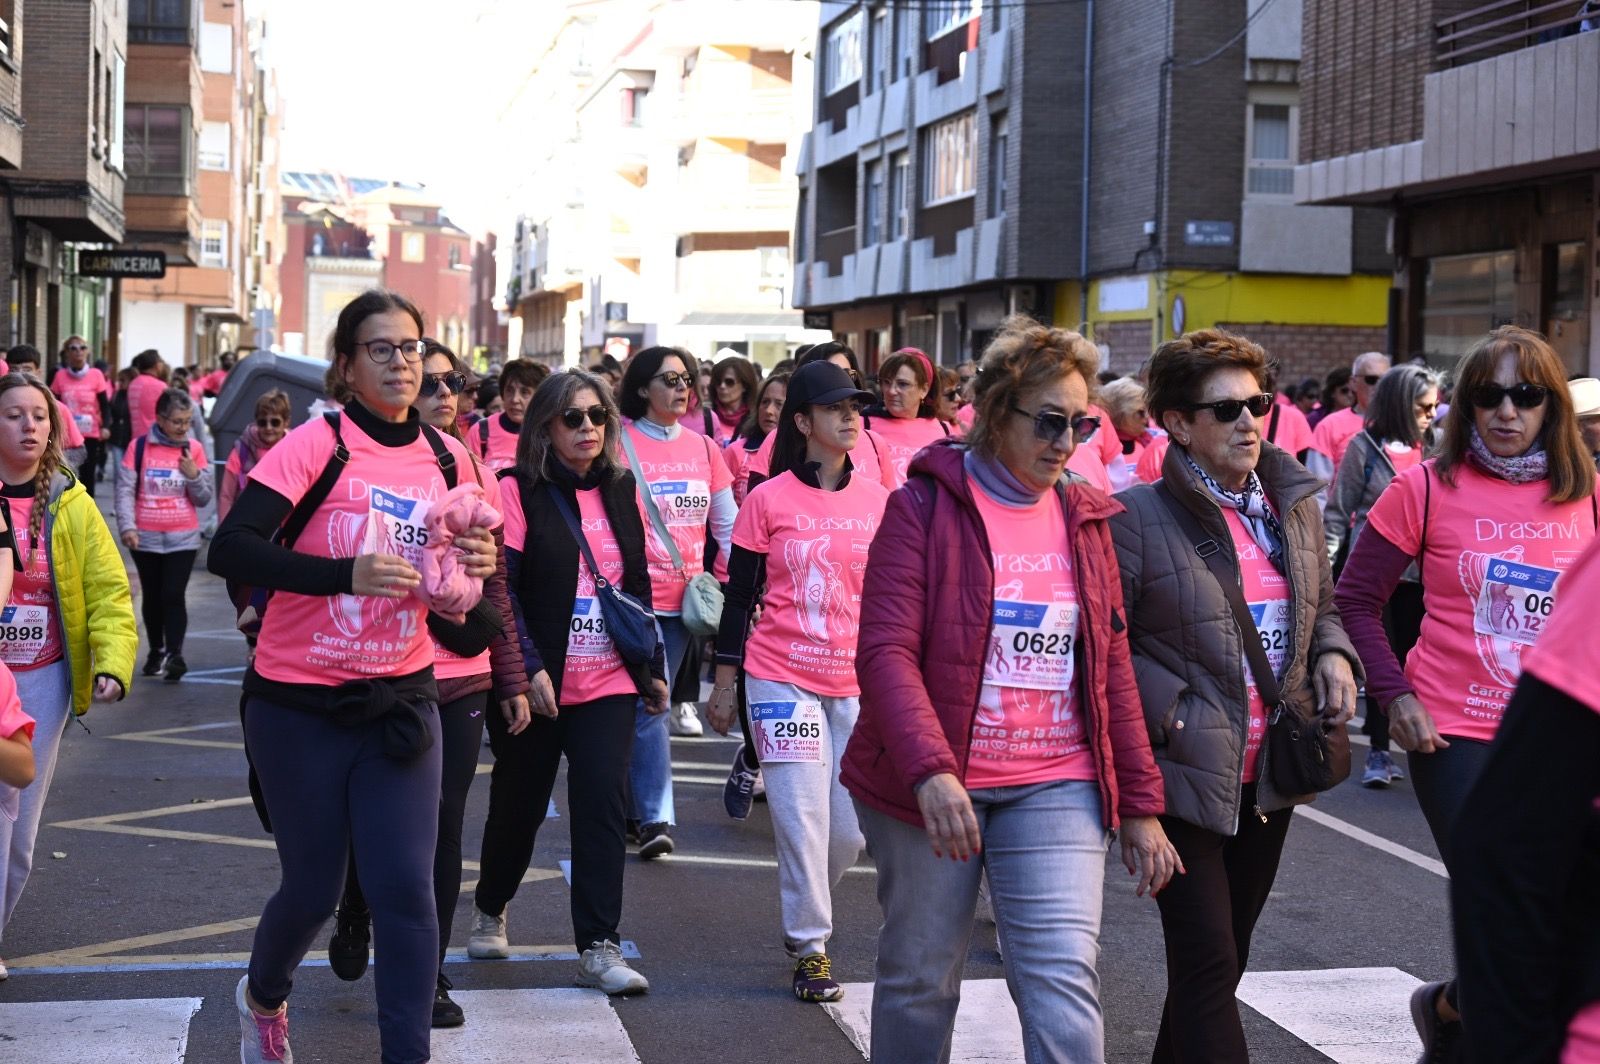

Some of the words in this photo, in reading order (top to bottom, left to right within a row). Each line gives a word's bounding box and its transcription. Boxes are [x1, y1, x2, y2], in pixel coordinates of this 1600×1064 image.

[83, 257, 162, 272] CARNICERIA
[675, 496, 708, 508] 0595
[1525, 593, 1554, 617] 06
[571, 617, 604, 634] 043
[313, 632, 361, 651] Carrera
[364, 640, 378, 652] de
[382, 641, 392, 652] la
[1013, 631, 1072, 655] 0623
[1260, 629, 1290, 650] 621
[791, 642, 831, 656] Carrera
[834, 648, 846, 657] de
[788, 652, 819, 665] almom
[1036, 656, 1068, 666] Carrera
[1469, 684, 1512, 699] Carre
[774, 722, 820, 738] 2965
[972, 725, 1007, 738] rera
[1012, 727, 1030, 739] de
[1033, 727, 1045, 739] la
